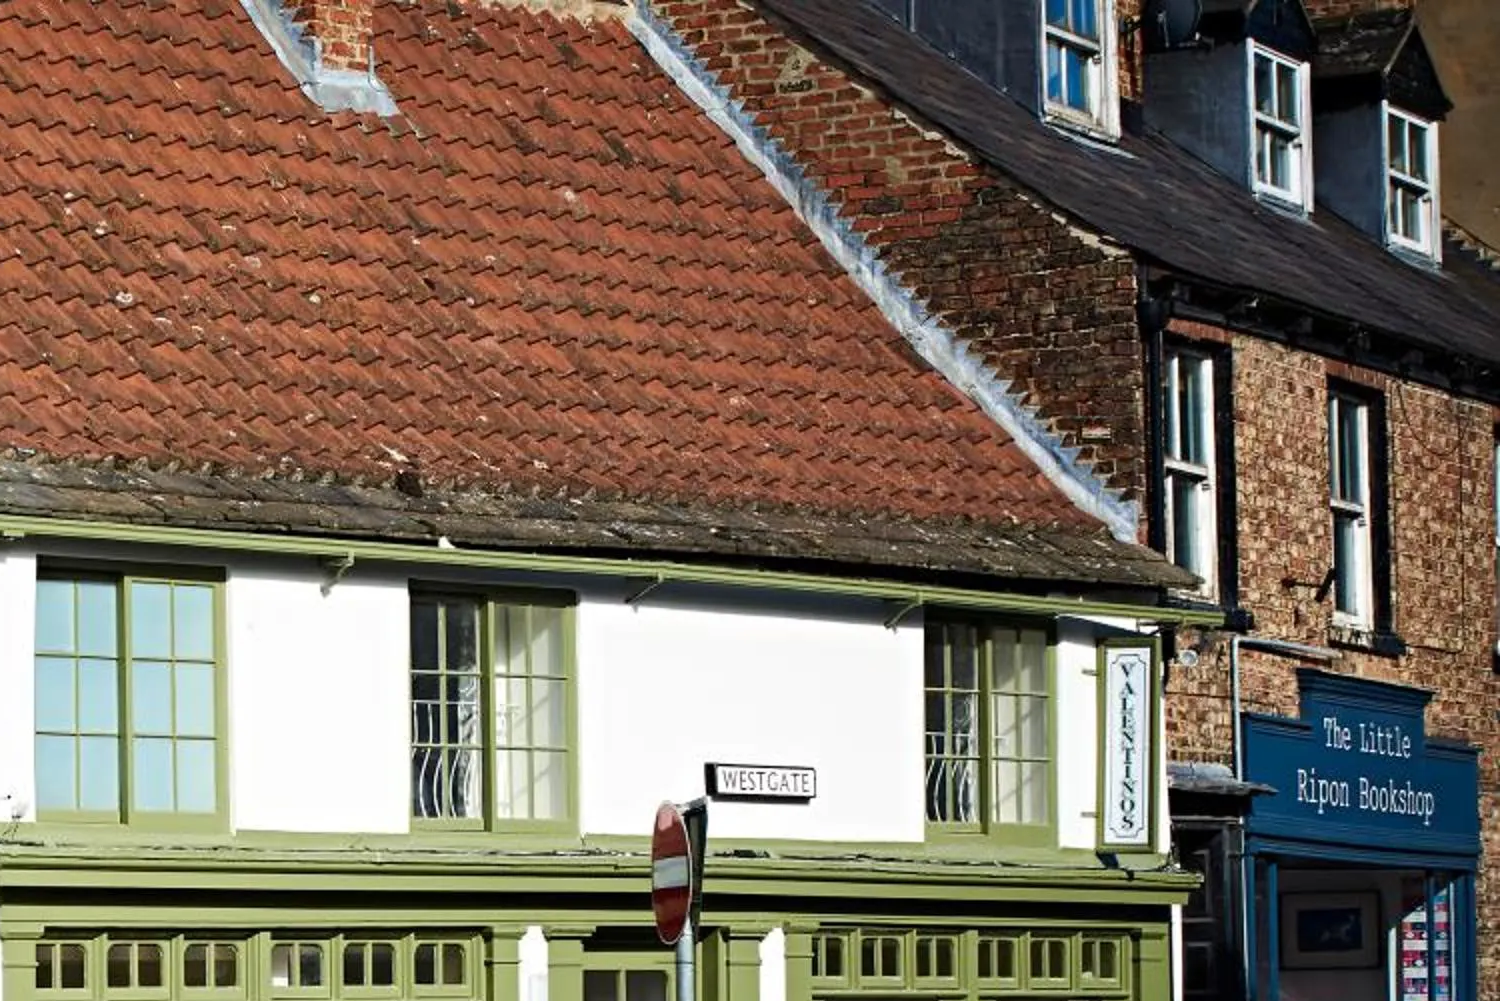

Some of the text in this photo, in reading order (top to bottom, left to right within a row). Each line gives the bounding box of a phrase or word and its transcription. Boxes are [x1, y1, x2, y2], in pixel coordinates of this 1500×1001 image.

[1323, 717, 1412, 759] The Little
[721, 769, 810, 793] WESTGATE
[1297, 767, 1435, 826] Ripon Bookshop
